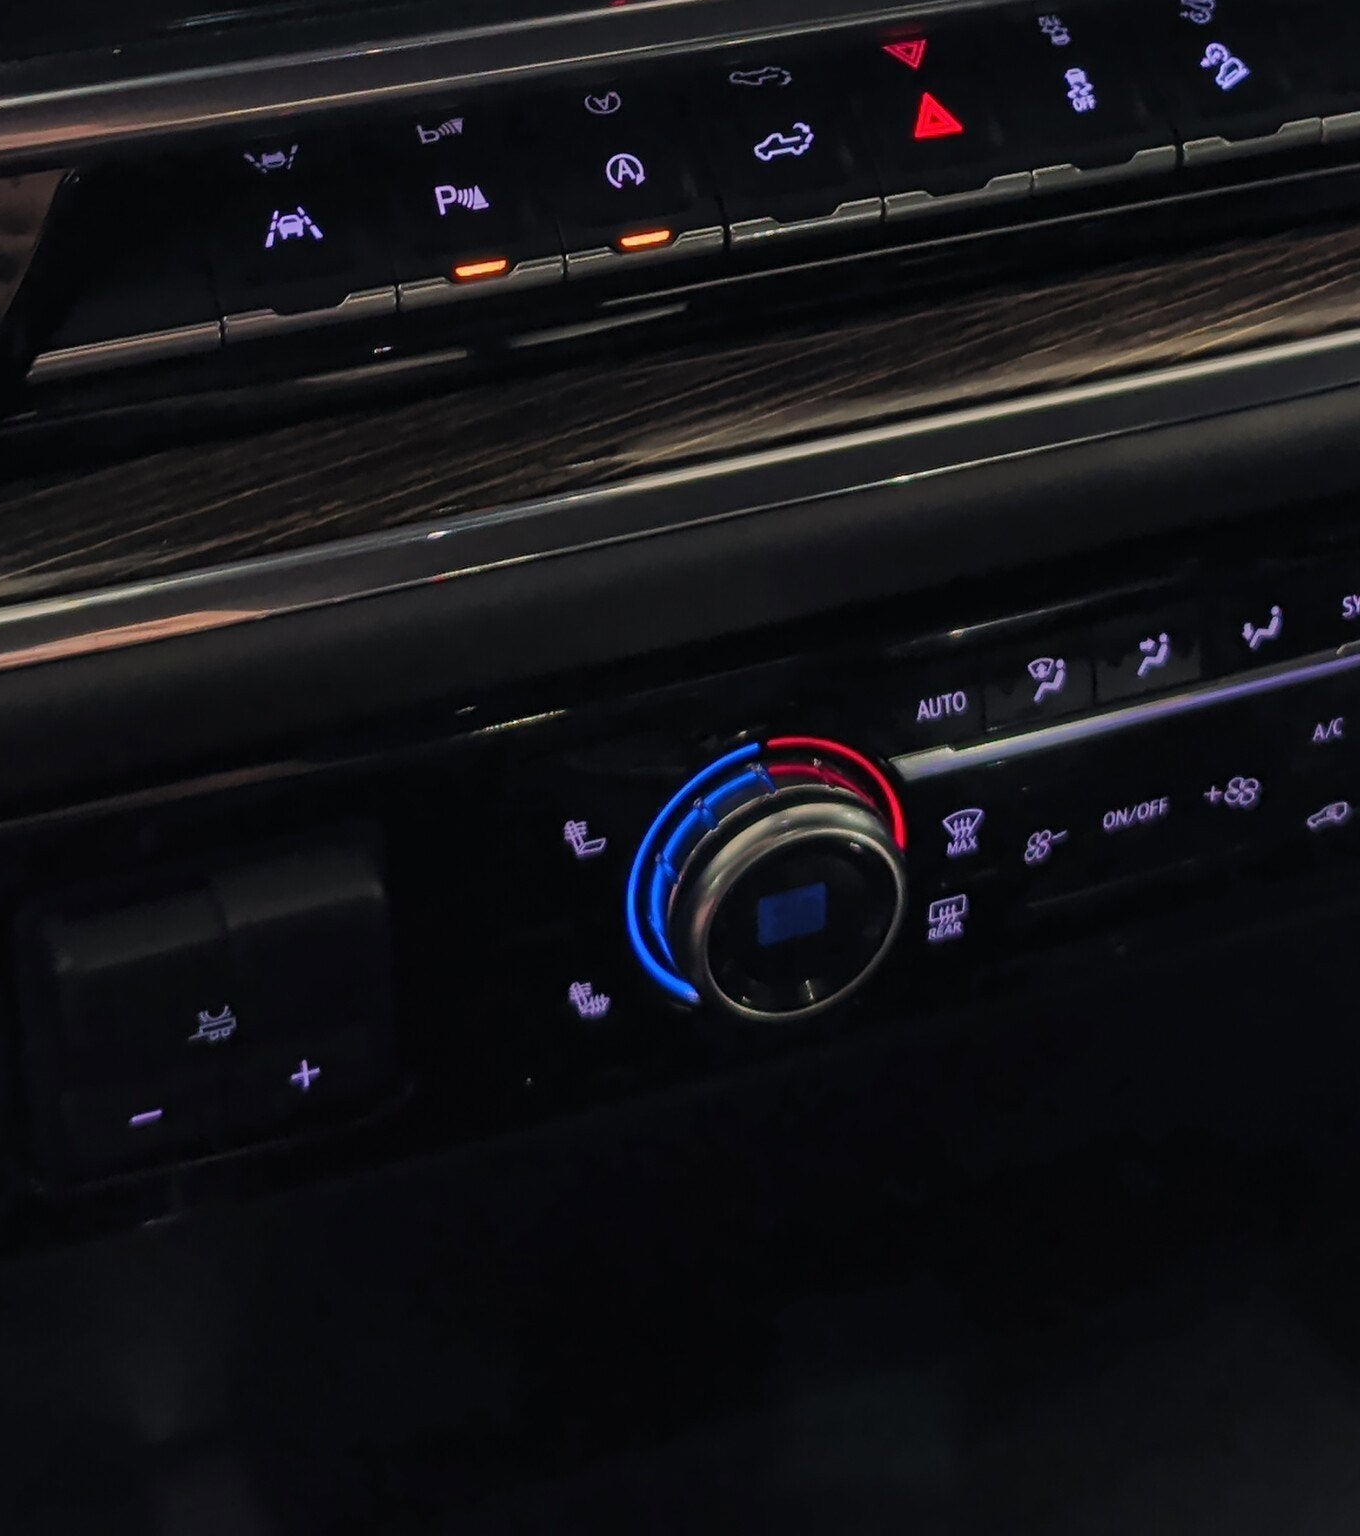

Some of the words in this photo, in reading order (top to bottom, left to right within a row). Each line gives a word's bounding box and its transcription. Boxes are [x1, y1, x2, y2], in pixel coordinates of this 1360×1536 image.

[917, 691, 966, 720] AUTO
[1313, 718, 1342, 741] A/C
[1103, 799, 1168, 827] ON/OFF
[947, 837, 977, 855] MAX
[928, 919, 961, 940] REAR
